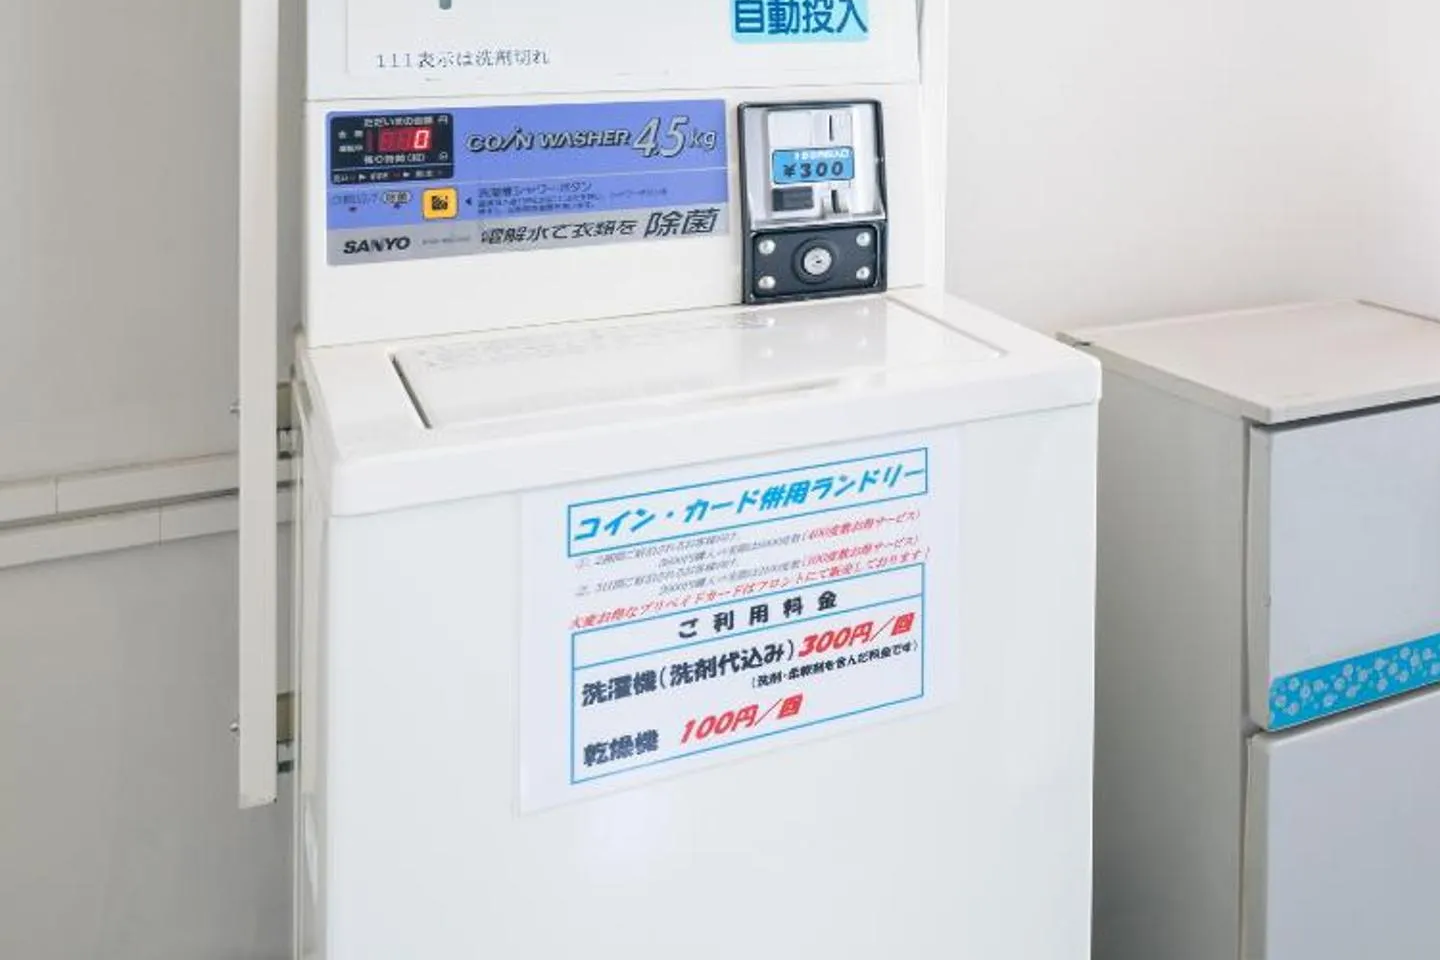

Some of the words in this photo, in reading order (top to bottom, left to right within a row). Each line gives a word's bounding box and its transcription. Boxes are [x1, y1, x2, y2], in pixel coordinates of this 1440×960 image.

[413, 129, 430, 149] 0
[538, 130, 630, 149] WASHER
[783, 161, 844, 178] ¥300
[644, 208, 721, 238] 除菌
[343, 236, 411, 256] SANYO
[573, 463, 925, 541] コイン・カード併用ランドリー
[678, 591, 839, 639] ご利用料金
[583, 730, 660, 768] 乾燥機
